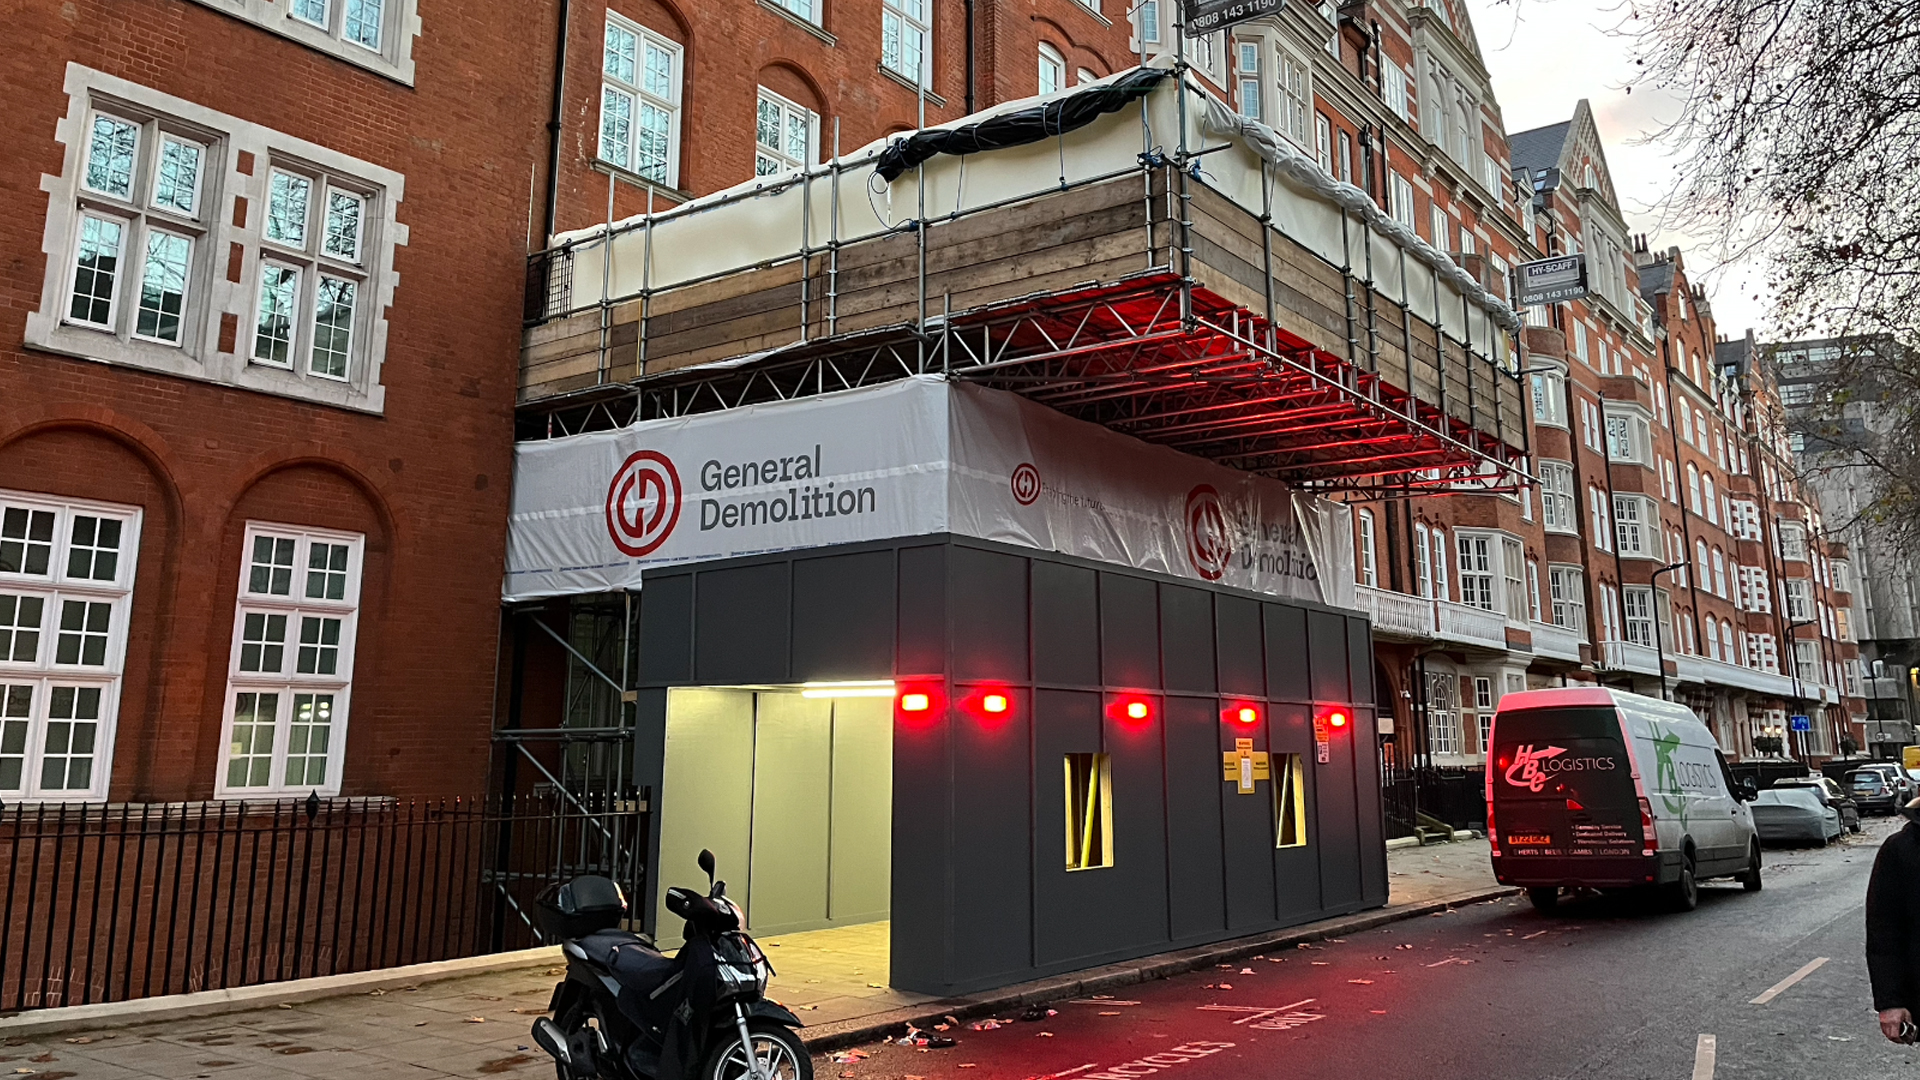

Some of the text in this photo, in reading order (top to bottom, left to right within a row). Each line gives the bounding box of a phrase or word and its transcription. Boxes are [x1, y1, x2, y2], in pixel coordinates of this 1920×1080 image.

[1191, 0, 1276, 29] 0808 143 1190
[1532, 261, 1573, 275] HY-SCAFF
[1523, 286, 1584, 303] 0808 143 1190
[700, 444, 821, 492] General
[700, 482, 876, 531] Demolition
[1542, 757, 1615, 771] LOGISTICS
[1071, 1040, 1236, 1080] RCYCLES
